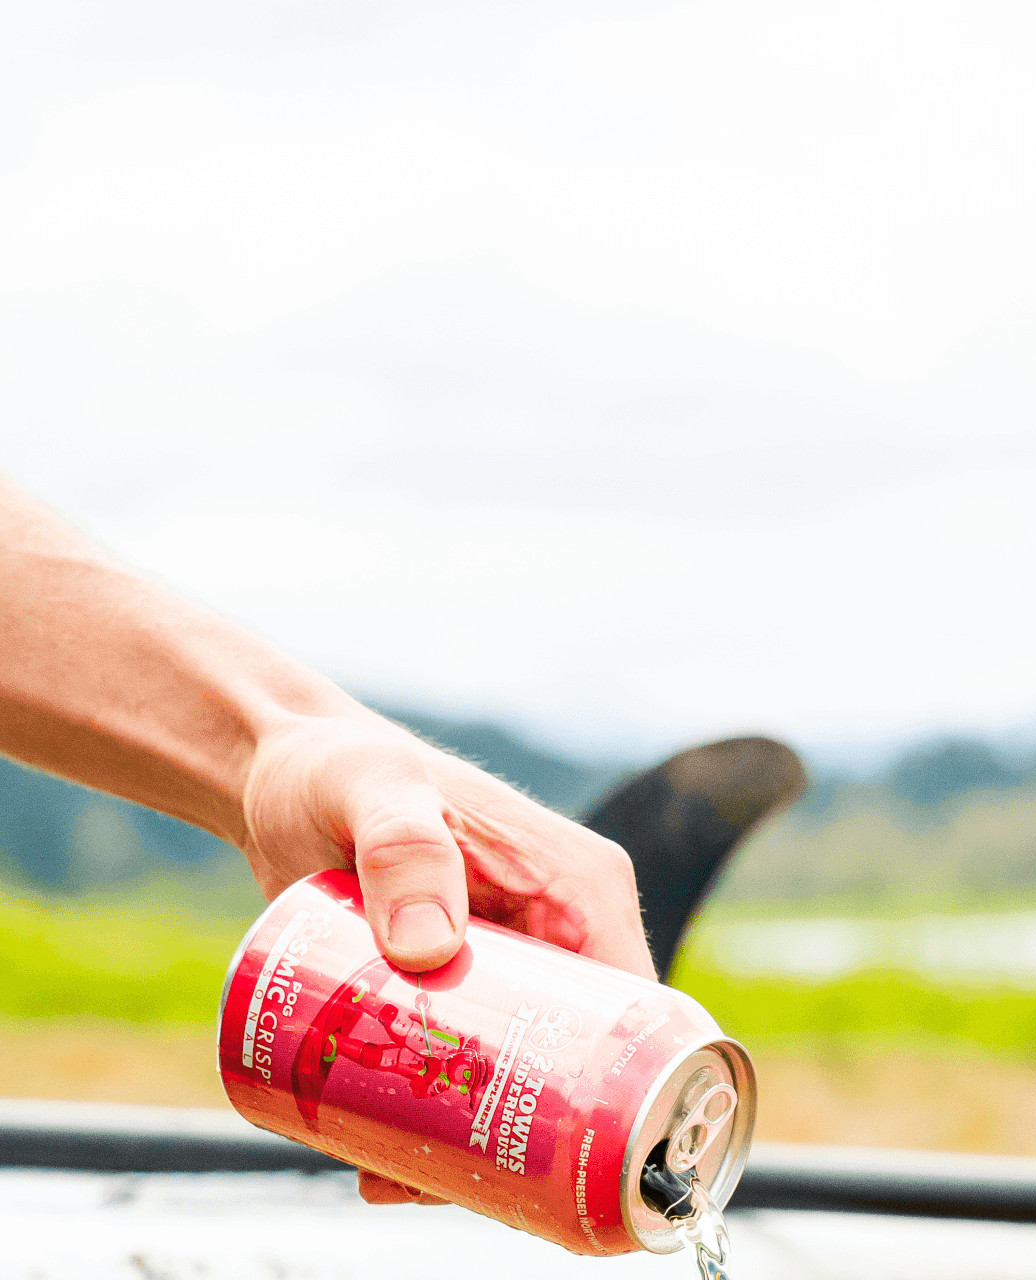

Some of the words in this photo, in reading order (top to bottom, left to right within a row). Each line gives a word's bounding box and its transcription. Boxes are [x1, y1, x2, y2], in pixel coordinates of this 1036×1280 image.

[282, 981, 303, 1017] POG
[502, 1025, 521, 1064] COSMIC
[611, 1043, 637, 1076] STYLE
[532, 1055, 554, 1074] 2
[508, 1078, 546, 1176] TOWNS
[575, 1128, 595, 1215] FRESH-PRESSED
